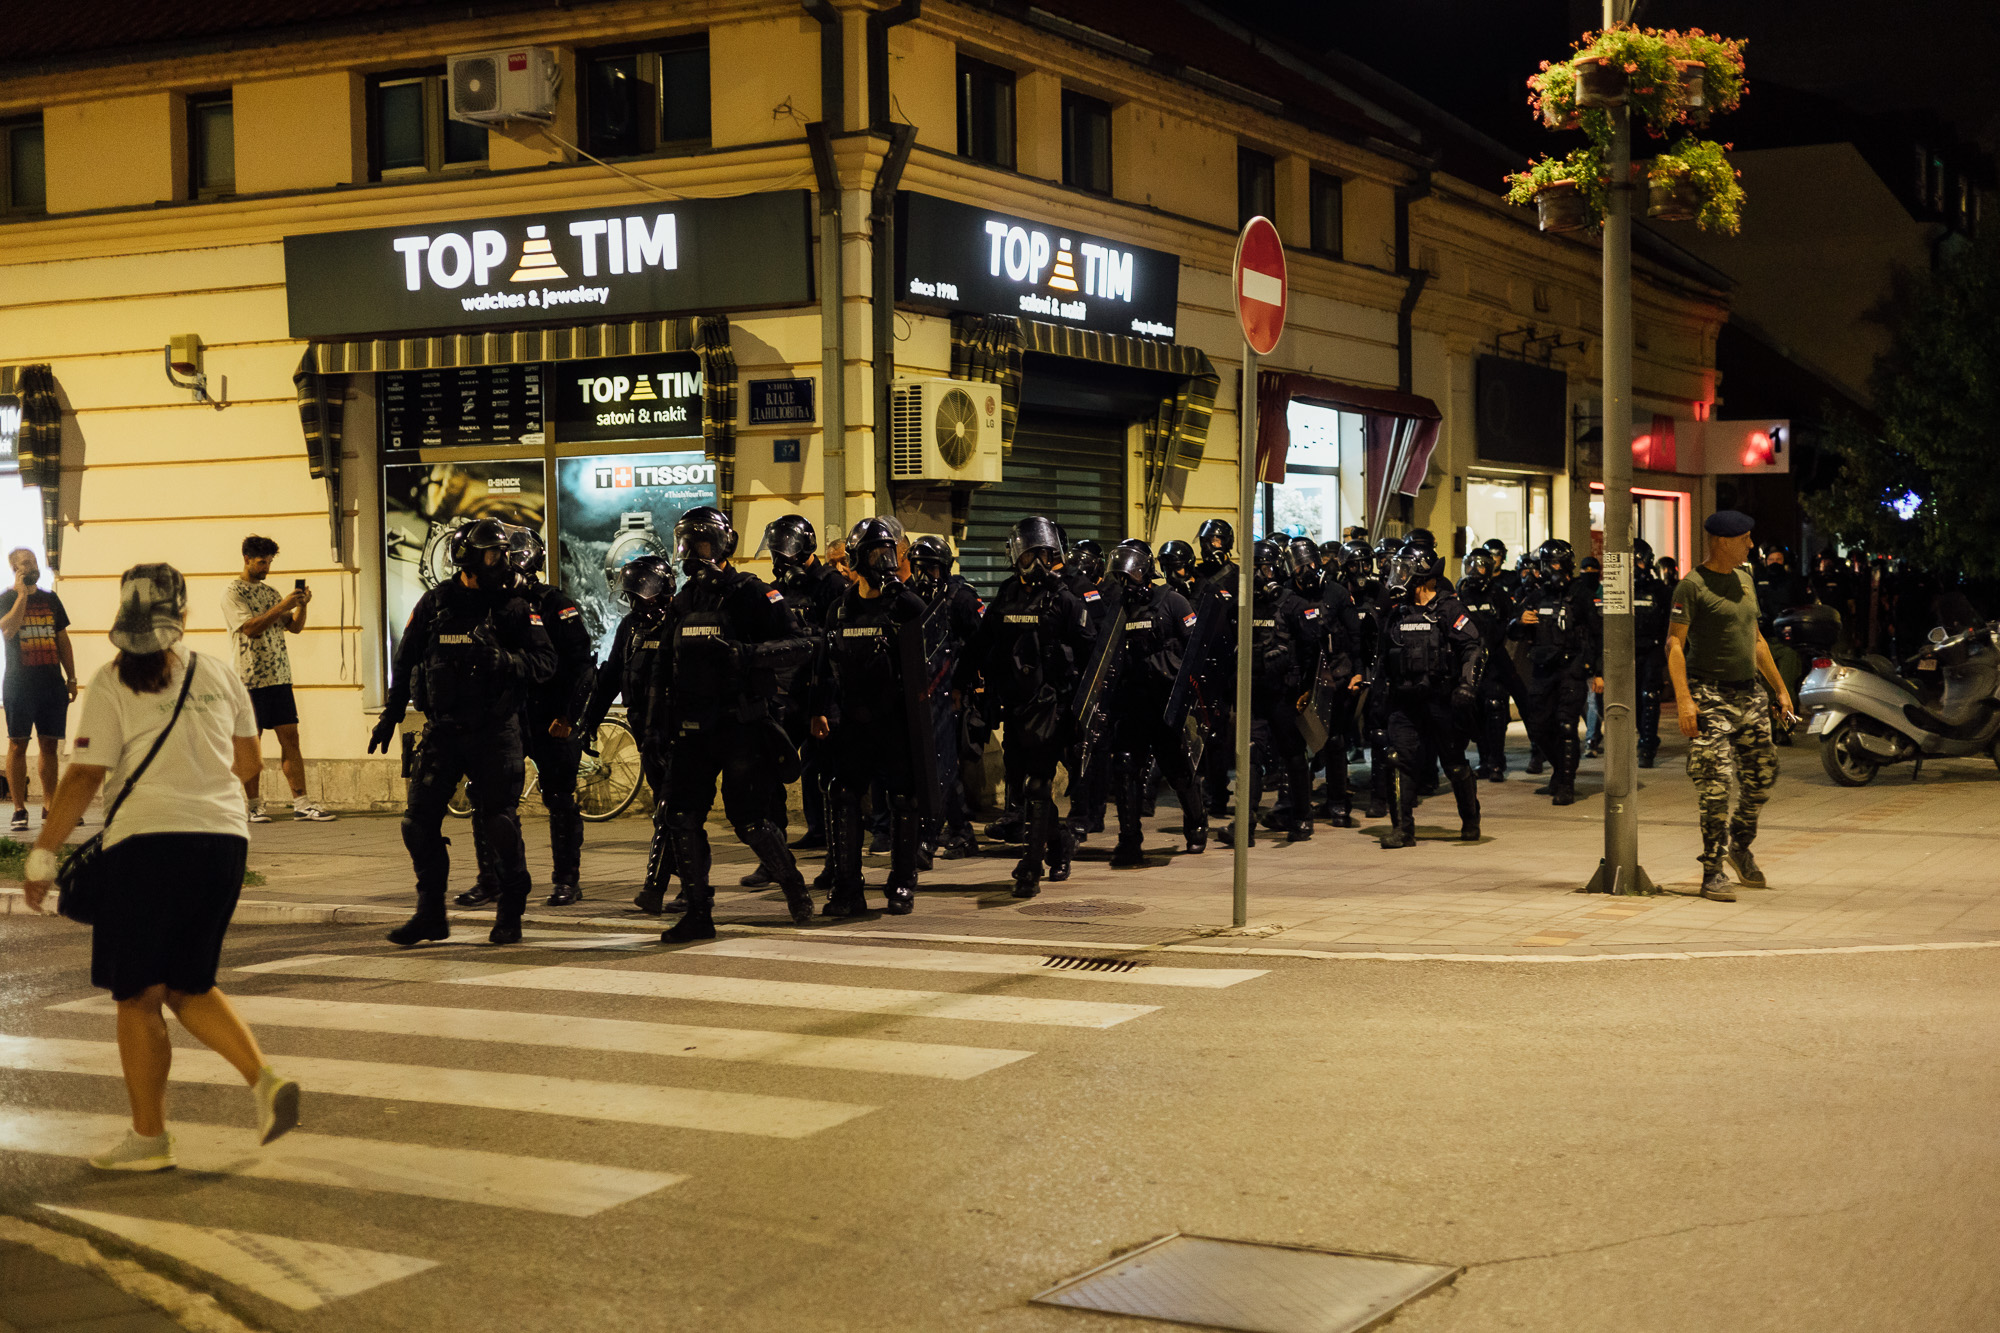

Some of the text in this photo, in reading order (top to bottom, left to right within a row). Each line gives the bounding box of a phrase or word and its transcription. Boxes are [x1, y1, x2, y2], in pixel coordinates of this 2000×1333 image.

[393, 213, 678, 291] TOP TIM
[985, 220, 1133, 302] TOP TIM
[910, 277, 935, 297] since
[461, 293, 526, 312] watches
[528, 290, 541, 307] &
[1019, 293, 1086, 320] satovi & nakit
[577, 371, 704, 403] TOP TIM
[765, 391, 796, 406] ВЛАДЕ
[0, 405, 21, 436] IM
[596, 405, 687, 426] satovi & nakit
[986, 419, 995, 428] LG
[635, 464, 716, 486] TISSOT
